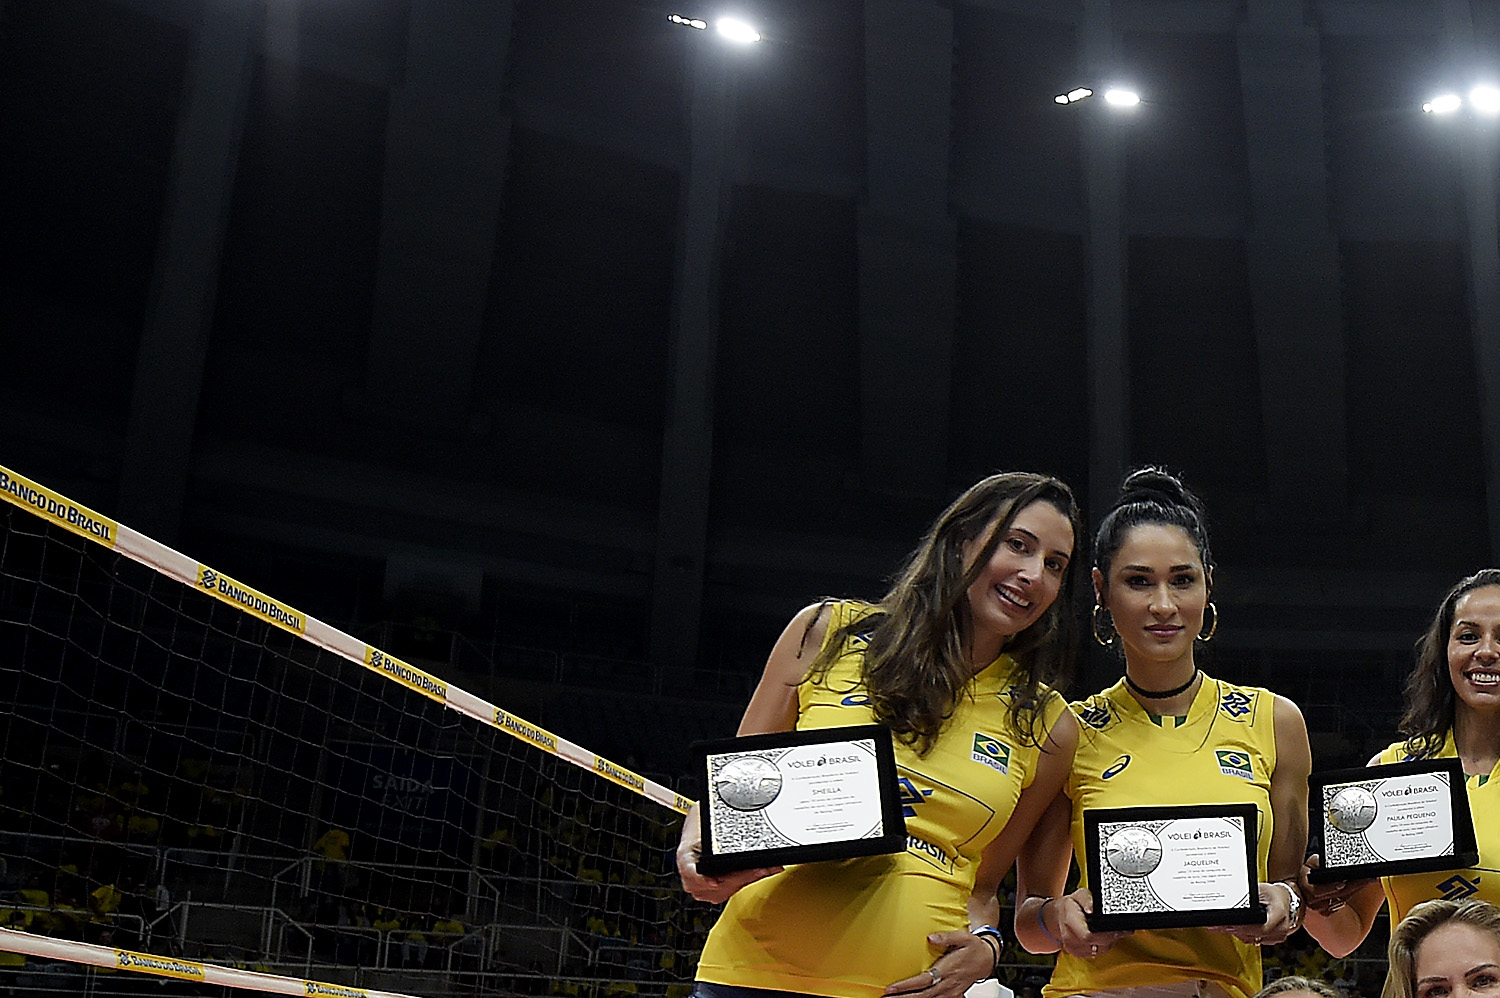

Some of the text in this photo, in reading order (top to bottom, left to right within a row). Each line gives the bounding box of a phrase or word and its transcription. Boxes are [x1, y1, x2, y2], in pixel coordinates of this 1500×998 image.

[0, 471, 111, 541] BANCO DO BRASIL
[218, 578, 301, 630] BANCO DO BRASIL
[384, 658, 447, 699] BANCO DO BRASIL
[829, 755, 861, 765] BRASIL
[973, 753, 1007, 775] BRASIL
[1221, 767, 1254, 781] BRASIL
[812, 787, 842, 796] SHEILLA
[1413, 785, 1439, 795] BRASIL
[1386, 811, 1437, 822] PAULA PEQUENO
[1203, 830, 1232, 839] BRASIL
[909, 835, 947, 866] RASIL
[1183, 859, 1220, 867] JAQUELINE
